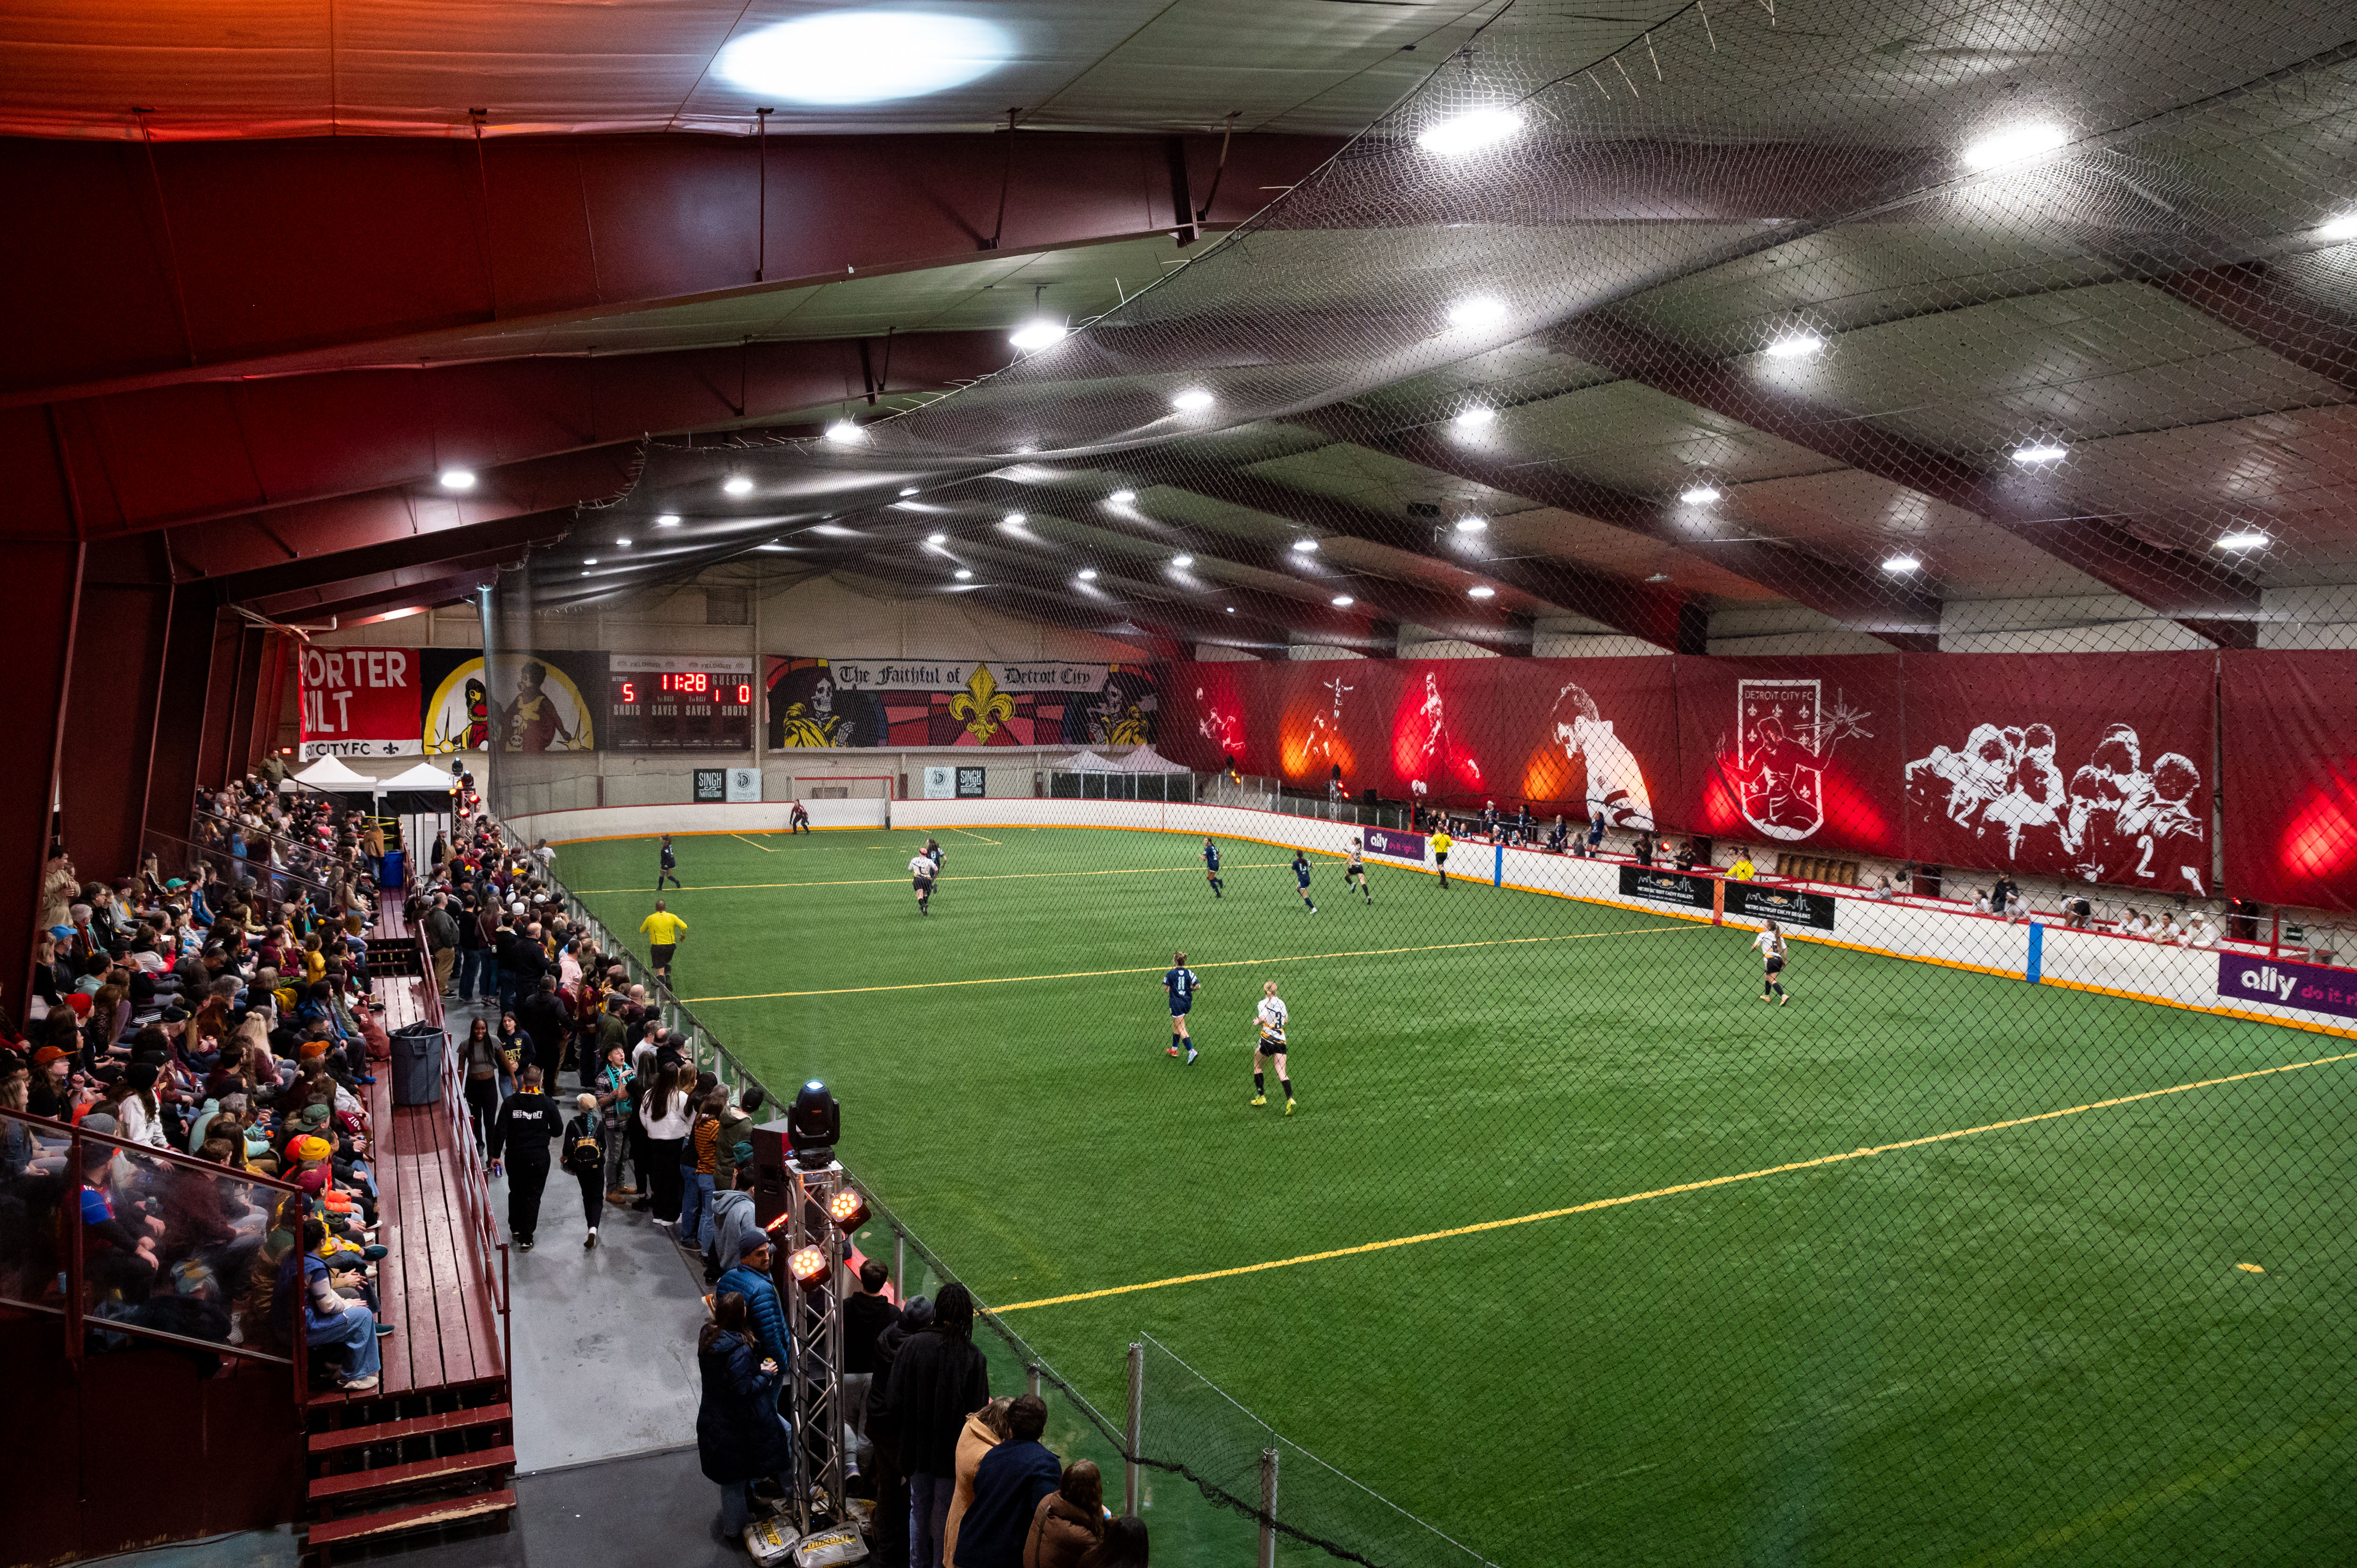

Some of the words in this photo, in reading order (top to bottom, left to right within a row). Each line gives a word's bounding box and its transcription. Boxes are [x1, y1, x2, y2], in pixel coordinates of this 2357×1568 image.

[662, 674, 707, 692] 11:28
[839, 665, 870, 683] The
[876, 665, 940, 686] Faithful
[946, 667, 962, 683] of
[1004, 667, 1057, 684] Detroit
[622, 683, 635, 703] 5
[739, 684, 750, 703] 0
[1745, 690, 1780, 700] DETROIT
[1781, 691, 1800, 701] CITY
[1802, 691, 1814, 701] FC
[613, 705, 641, 716] SHOTS
[651, 705, 678, 716] SAVES
[685, 705, 711, 716] SAVES
[699, 772, 722, 787] SINGH
[960, 770, 981, 783] SINGH
[1370, 832, 1388, 852] ally
[2241, 966, 2298, 1001] ally
[2301, 985, 2324, 1000] do
[2328, 987, 2343, 1003] it
[1274, 1011, 1282, 1029] 3
[505, 1048, 521, 1057] DET
